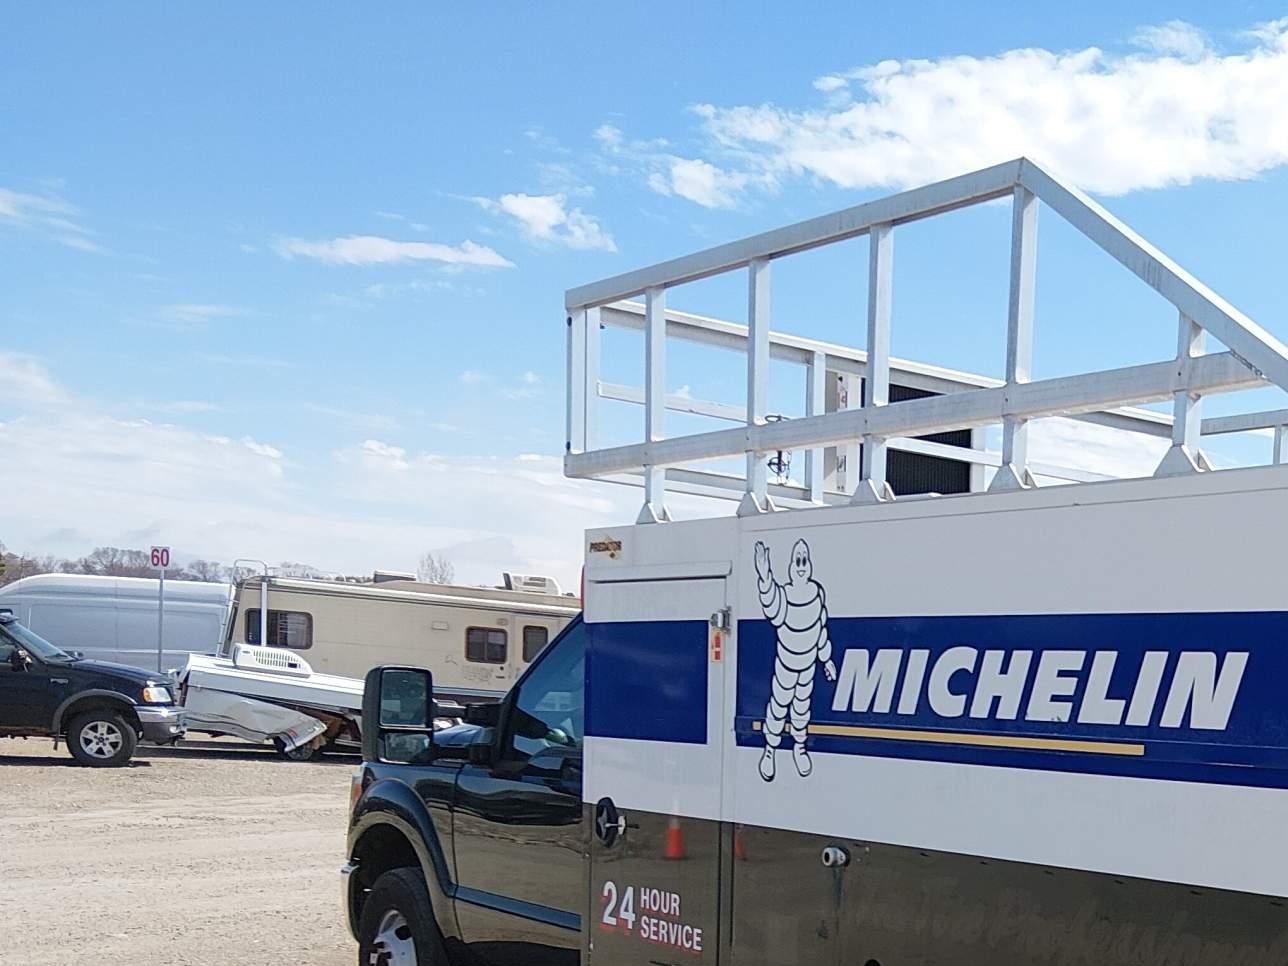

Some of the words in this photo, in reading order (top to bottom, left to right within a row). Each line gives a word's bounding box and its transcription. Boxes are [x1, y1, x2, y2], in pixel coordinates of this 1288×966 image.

[151, 548, 170, 567] 60
[831, 646, 1249, 731] MICHELIN
[602, 881, 636, 930] 24
[640, 887, 680, 916] HOUR
[640, 915, 703, 952] SERVICE
